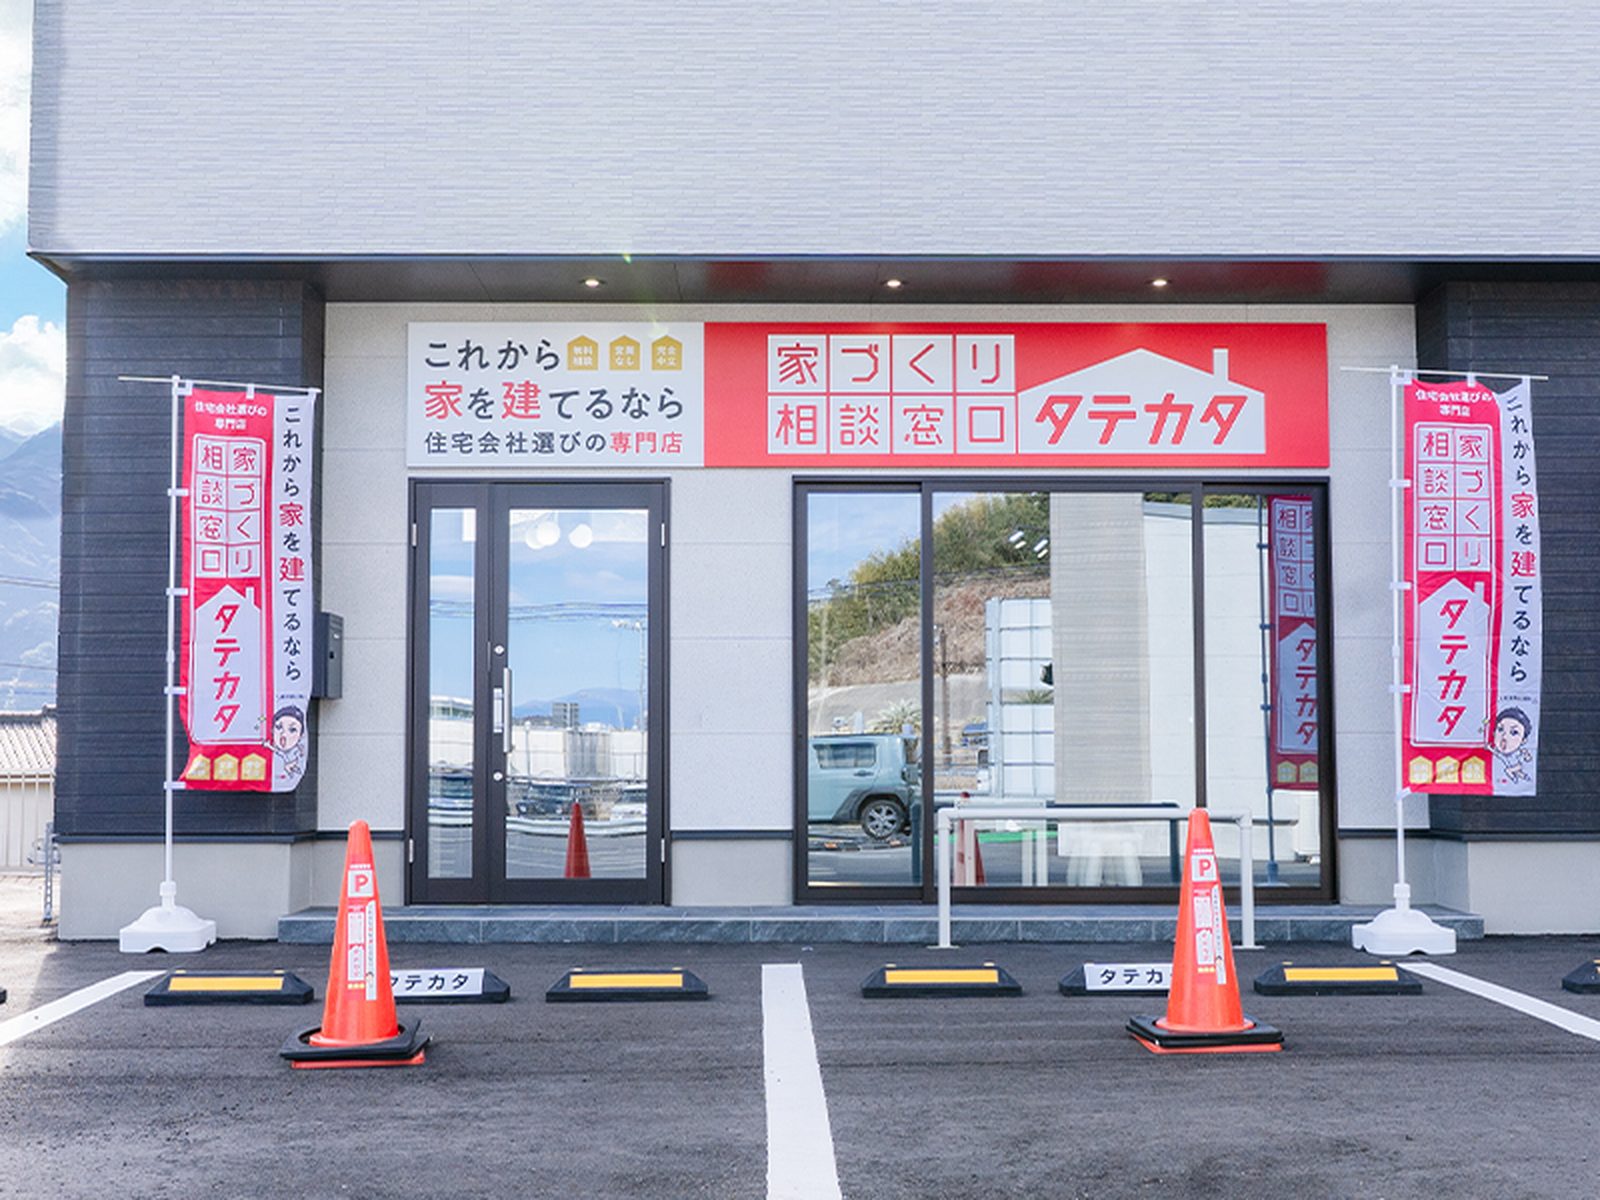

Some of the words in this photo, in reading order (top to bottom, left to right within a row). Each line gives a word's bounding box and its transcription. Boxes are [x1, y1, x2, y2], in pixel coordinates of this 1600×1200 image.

[425, 339, 560, 371] これから
[777, 343, 1001, 384] 家づくり
[425, 380, 683, 420] 家を建てるなら
[1035, 393, 1248, 445] タテカタ
[425, 432, 683, 454] 住宅会社選びの専門店
[775, 403, 1004, 446] 相談窓口
[201, 445, 224, 572] 相談窓口
[232, 447, 257, 573] 家づくり
[1423, 432, 1449, 565] 相談窓口
[1459, 435, 1484, 566] 家づくり
[280, 407, 305, 681] これから家を建てるなら
[213, 604, 241, 733] タテカタ
[1437, 599, 1469, 736] タテカタ
[355, 874, 369, 892] P
[1199, 859, 1211, 877] P
[1100, 968, 1173, 985] タテカ
